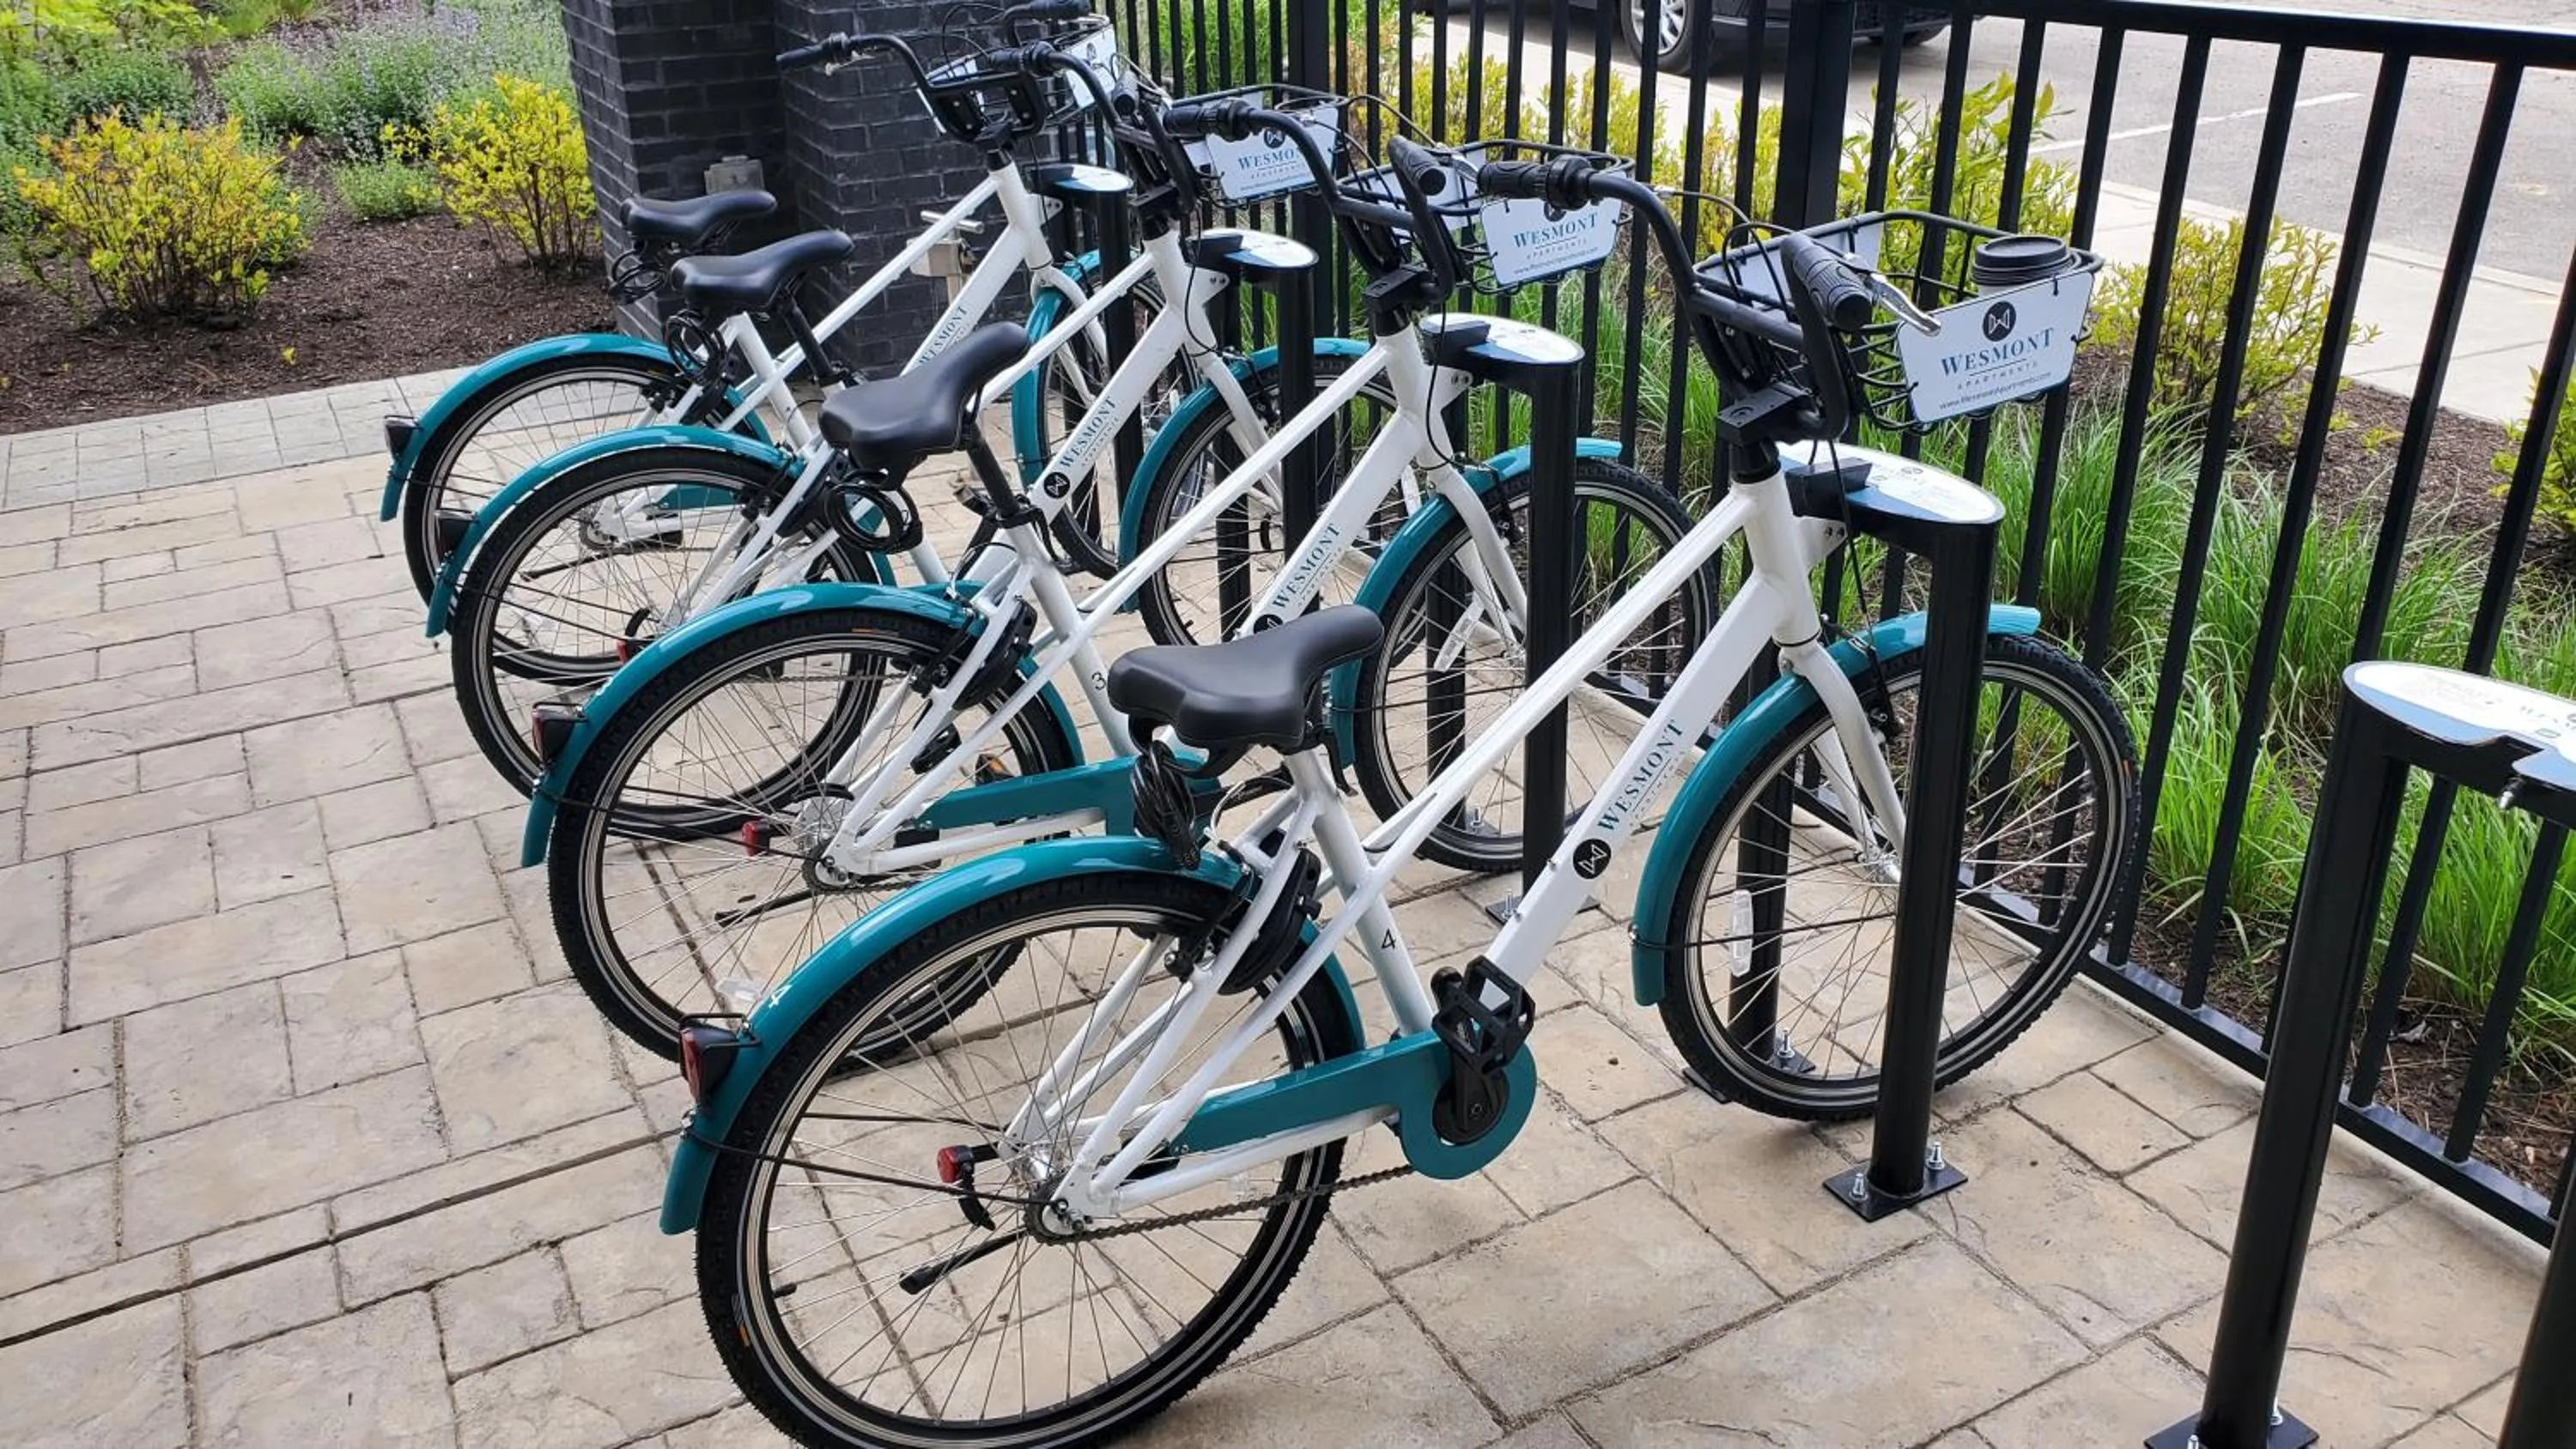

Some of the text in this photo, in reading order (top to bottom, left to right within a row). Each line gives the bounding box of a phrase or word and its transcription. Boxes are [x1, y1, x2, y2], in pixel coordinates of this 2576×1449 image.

[1513, 212, 1598, 248] WESMONT
[1940, 327, 2055, 378] WESMONT
[1957, 361, 2038, 390] APARTMENTS
[1059, 396, 1116, 467] WESMONT
[1272, 523, 1341, 608] WESMONT
[1091, 671, 1107, 691] 3
[1597, 718, 1684, 831] WESMONT
[1381, 928, 1396, 949] 4
